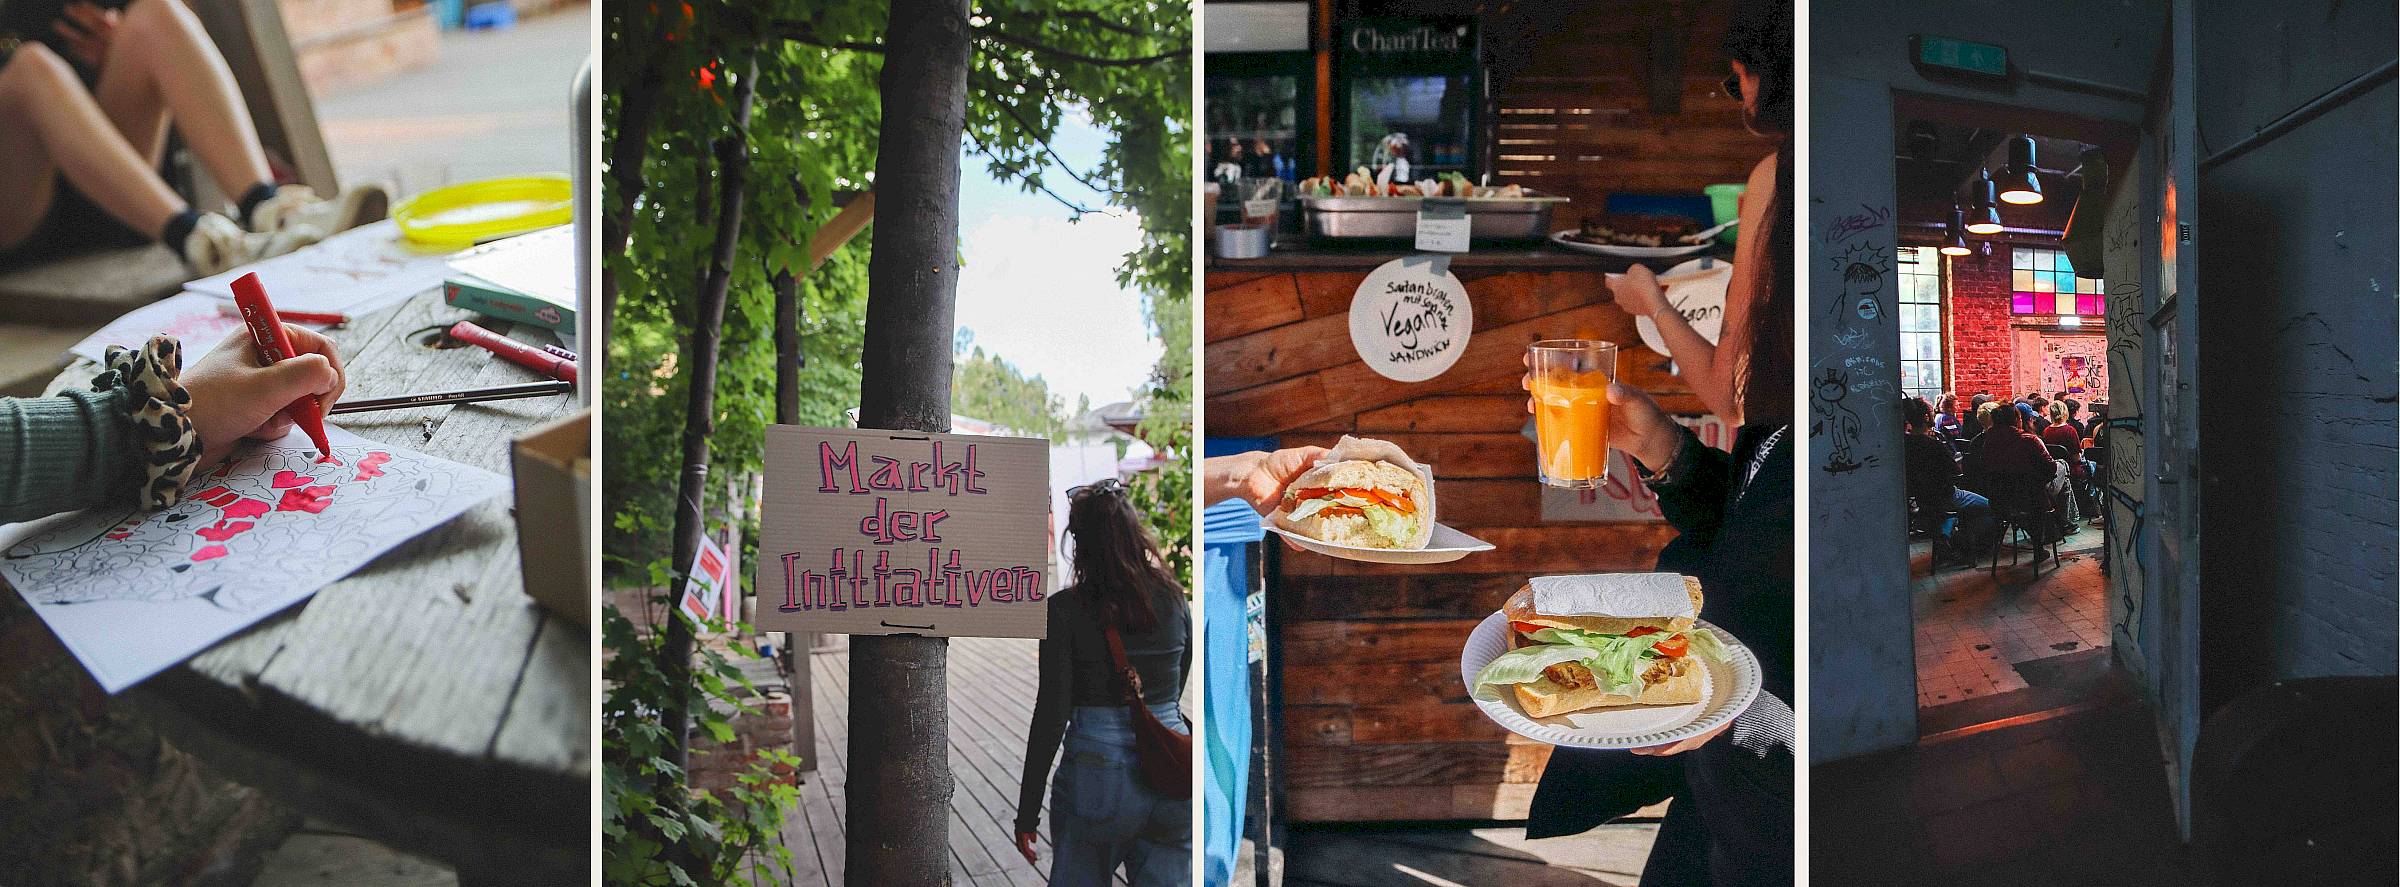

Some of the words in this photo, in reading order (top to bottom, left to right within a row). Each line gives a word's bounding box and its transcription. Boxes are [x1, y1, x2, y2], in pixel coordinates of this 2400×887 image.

[1351, 26, 1458, 52] ChariTea
[1381, 301, 1437, 350] Vegan
[818, 441, 987, 495] Markt
[859, 497, 949, 544] der
[778, 548, 1045, 612] Initiativen
